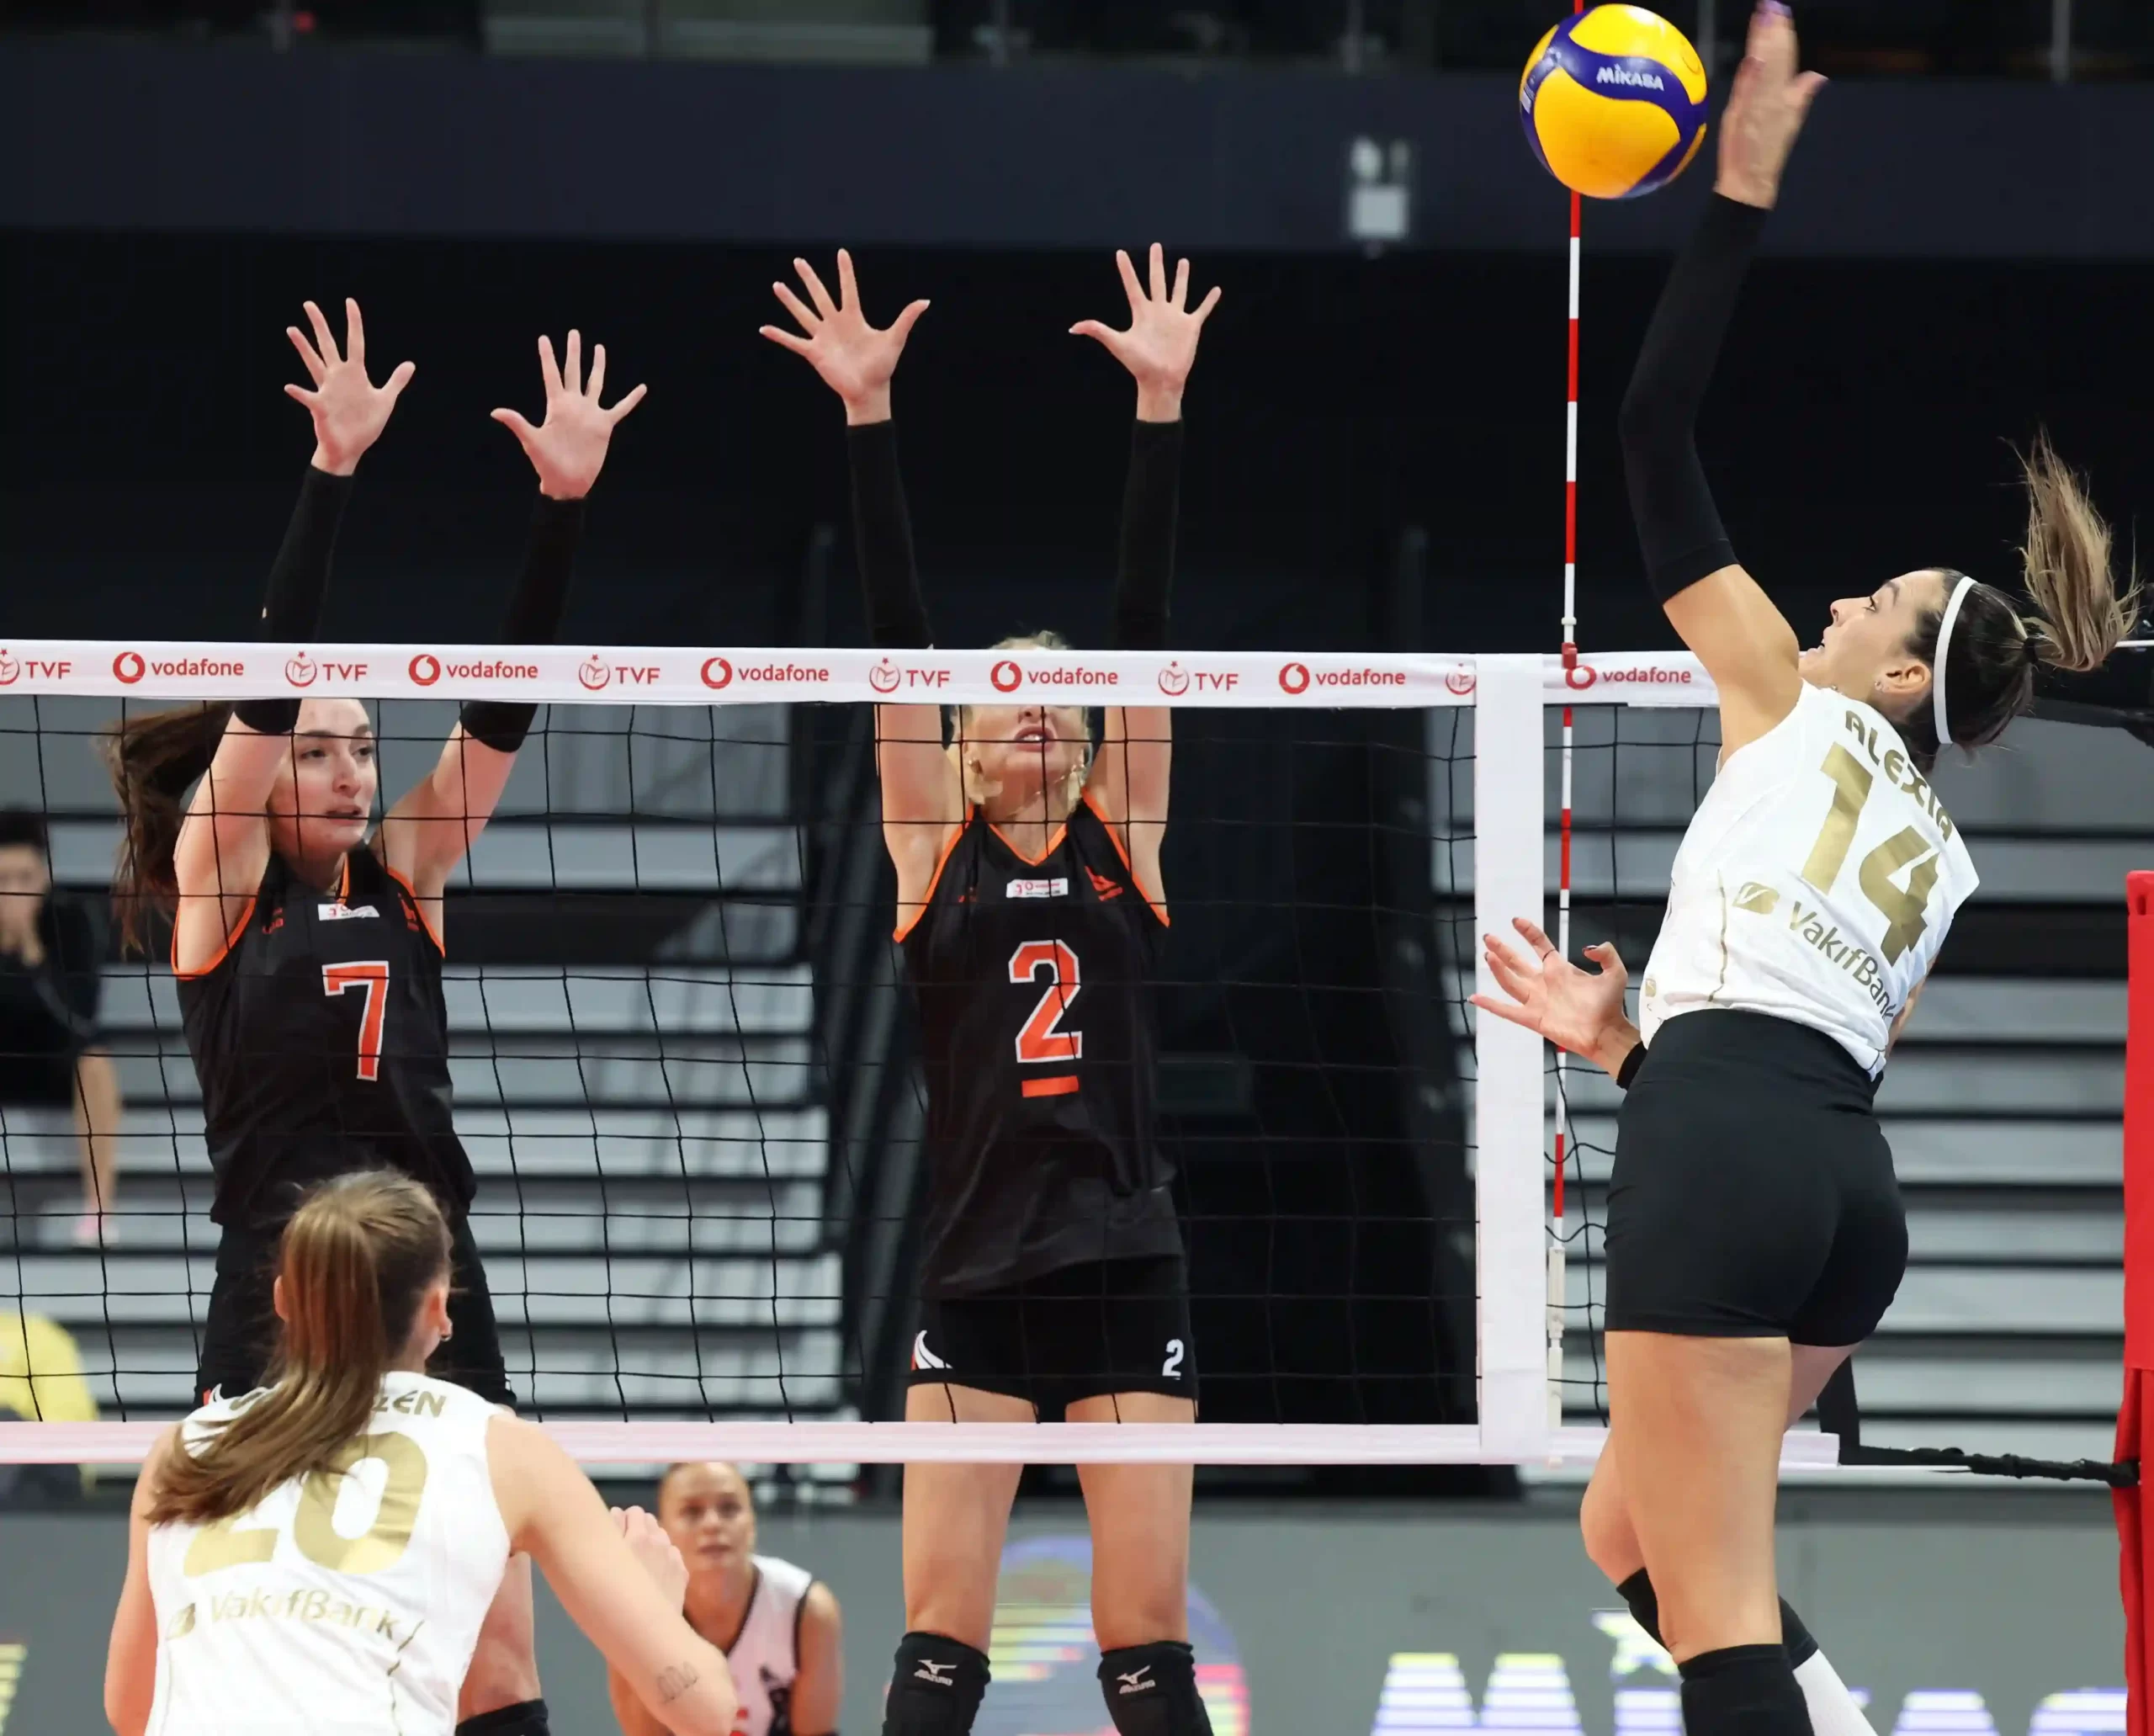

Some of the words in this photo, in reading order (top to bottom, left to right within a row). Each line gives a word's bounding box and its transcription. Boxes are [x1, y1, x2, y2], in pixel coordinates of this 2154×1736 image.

[26, 661, 72, 679] TVF
[151, 659, 245, 677] vodafone
[322, 663, 368, 681] TVF
[446, 661, 539, 679] vodafone
[615, 666, 661, 684] TVF
[738, 664, 830, 682] vodafone
[906, 670, 951, 687] TVF
[1028, 666, 1118, 685] vodafone
[1196, 673, 1239, 690] TVF
[1315, 668, 1406, 687] vodafone
[1602, 667, 1691, 684] vodafone
[1844, 710, 1954, 843] ALEXIA
[1801, 741, 1940, 967] 14
[322, 961, 390, 1081] 7
[1009, 939, 1082, 1063] 2
[1162, 1339, 1184, 1380] 2
